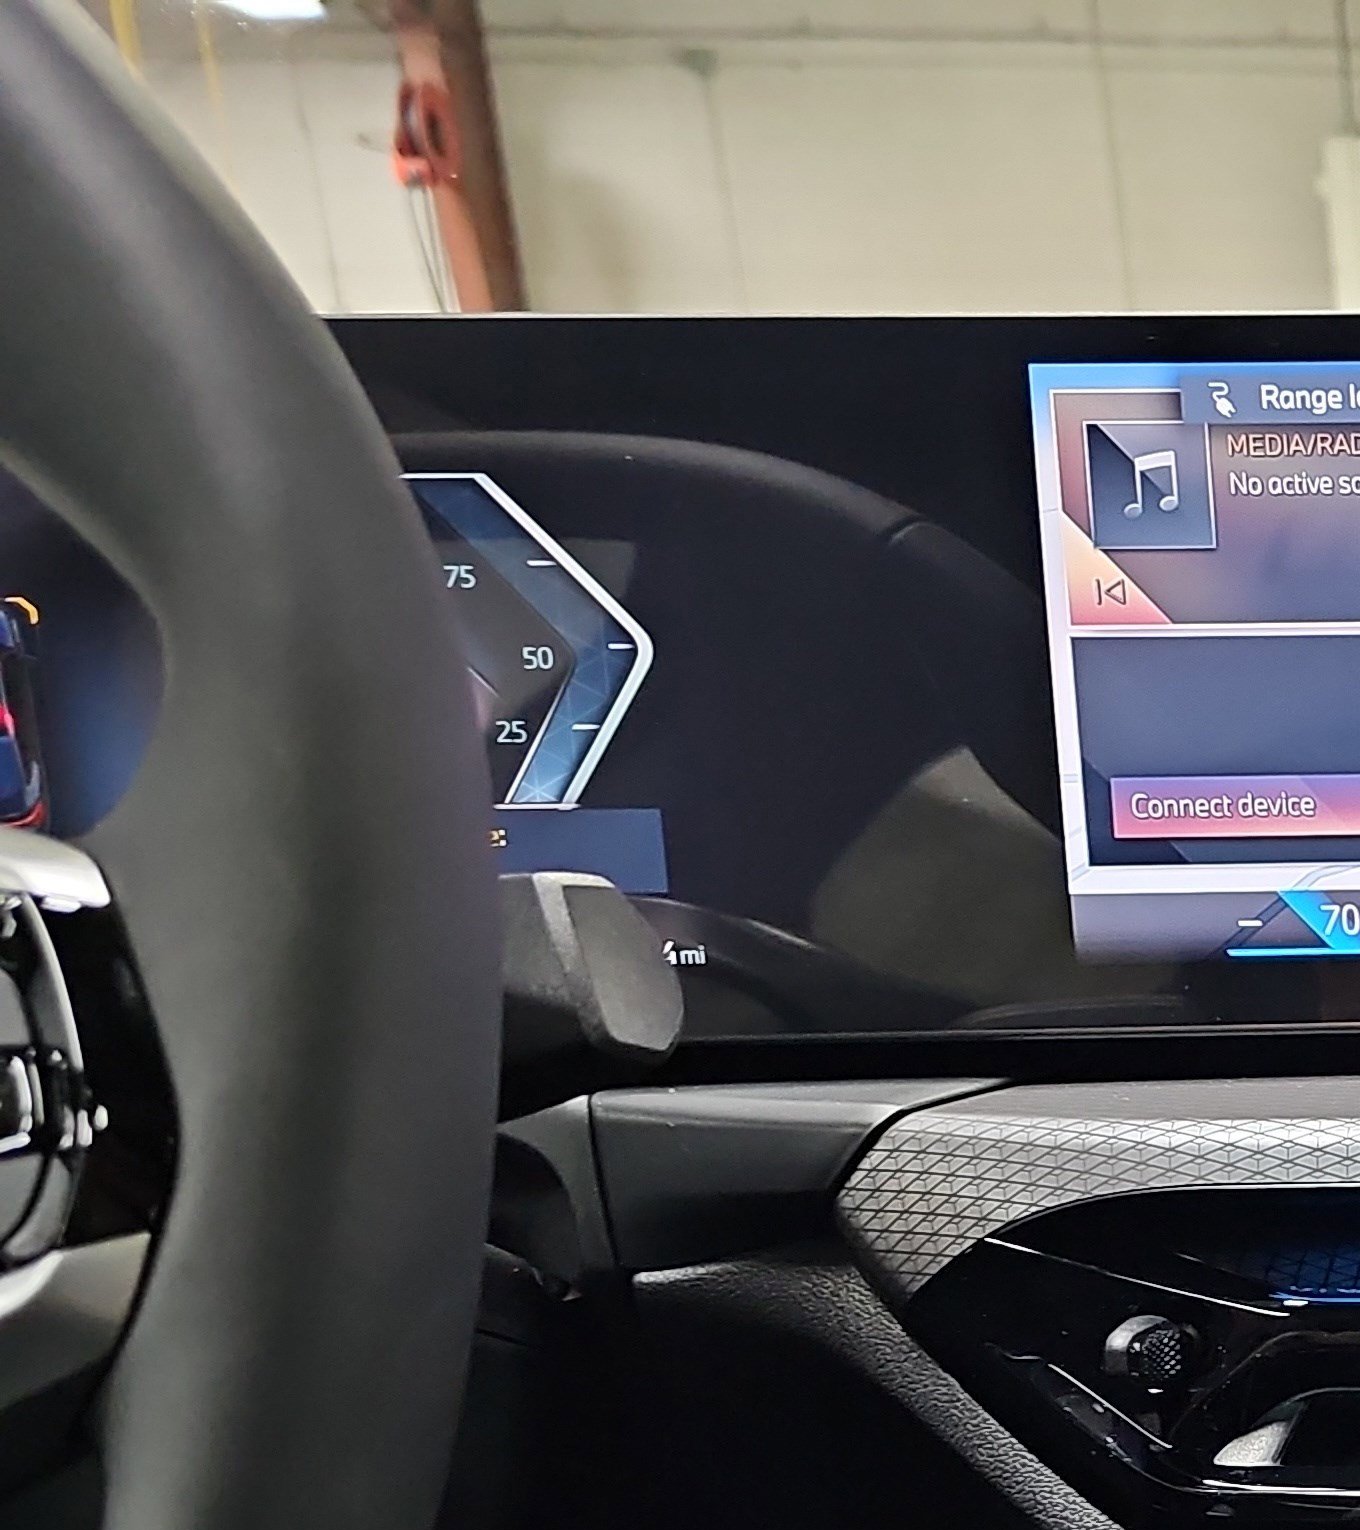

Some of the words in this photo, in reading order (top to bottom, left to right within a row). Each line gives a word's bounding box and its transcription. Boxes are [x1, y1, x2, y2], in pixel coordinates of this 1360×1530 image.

[1259, 383, 1342, 414] Range
[1229, 472, 1263, 495] No
[1267, 472, 1333, 495] active
[443, 565, 477, 589] 75
[521, 646, 554, 670] 50
[495, 720, 528, 743] 25
[1131, 793, 1233, 819] Connect
[1237, 791, 1316, 817] device
